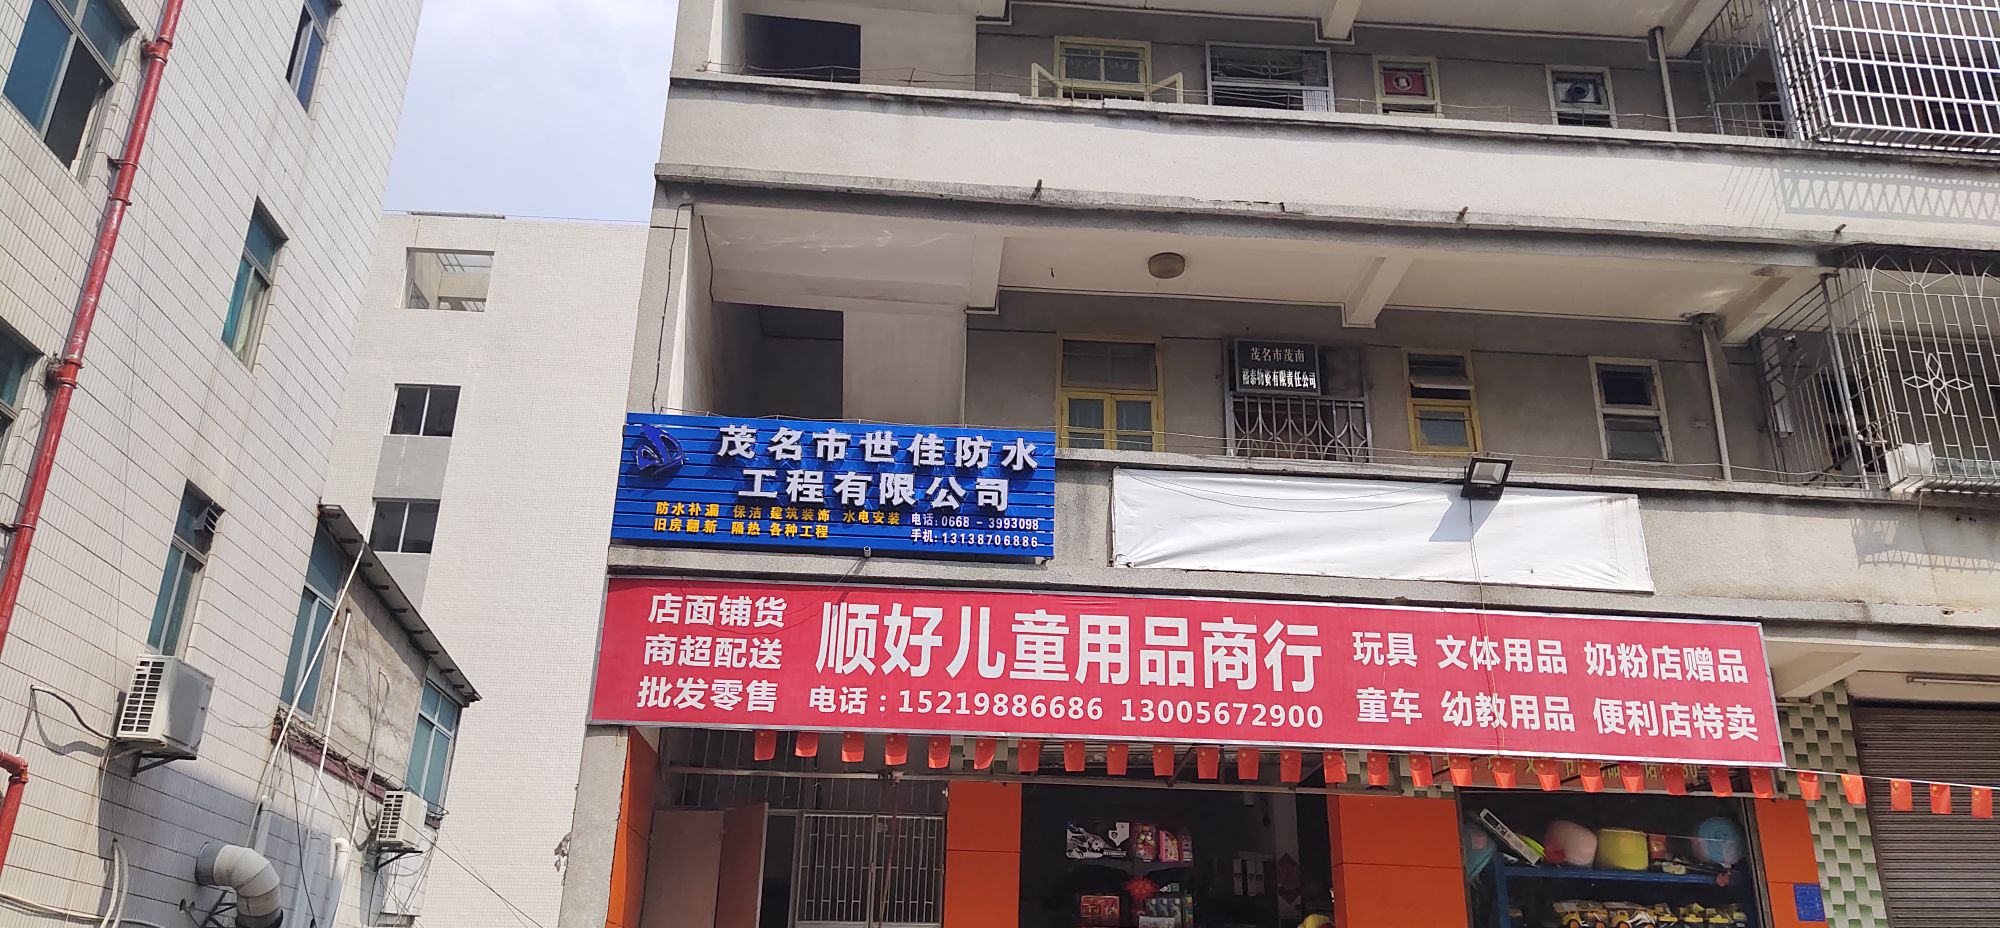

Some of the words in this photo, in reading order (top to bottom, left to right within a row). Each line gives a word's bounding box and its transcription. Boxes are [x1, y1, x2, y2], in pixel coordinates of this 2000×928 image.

[1249, 346, 1305, 363] 茂名市茂南
[717, 424, 1039, 471] 茂名市世佳防水
[738, 468, 1010, 511] 工程有限公司
[653, 517, 718, 534] 旧房翻新
[731, 521, 761, 536] 隔热
[769, 523, 830, 538] 各种工程
[655, 501, 720, 518] 防水补漏
[733, 504, 762, 519] 保洁
[769, 505, 831, 523] 建筑装饰
[842, 509, 901, 526] 水电安装
[647, 592, 788, 629] 店面铺货
[643, 633, 784, 670] 商超配送
[815, 601, 1323, 693] 顺好儿童用品商行
[1352, 631, 1418, 668] 玩具
[1435, 636, 1568, 675] 文体用品
[1583, 640, 1749, 684] 奶粉店赠品
[636, 675, 779, 713] 批发零售
[1120, 698, 1324, 728] 13005672900
[1356, 687, 1423, 725] 童车
[1441, 690, 1576, 732] 幼教用品
[1593, 698, 1760, 742] 便利店特卖
